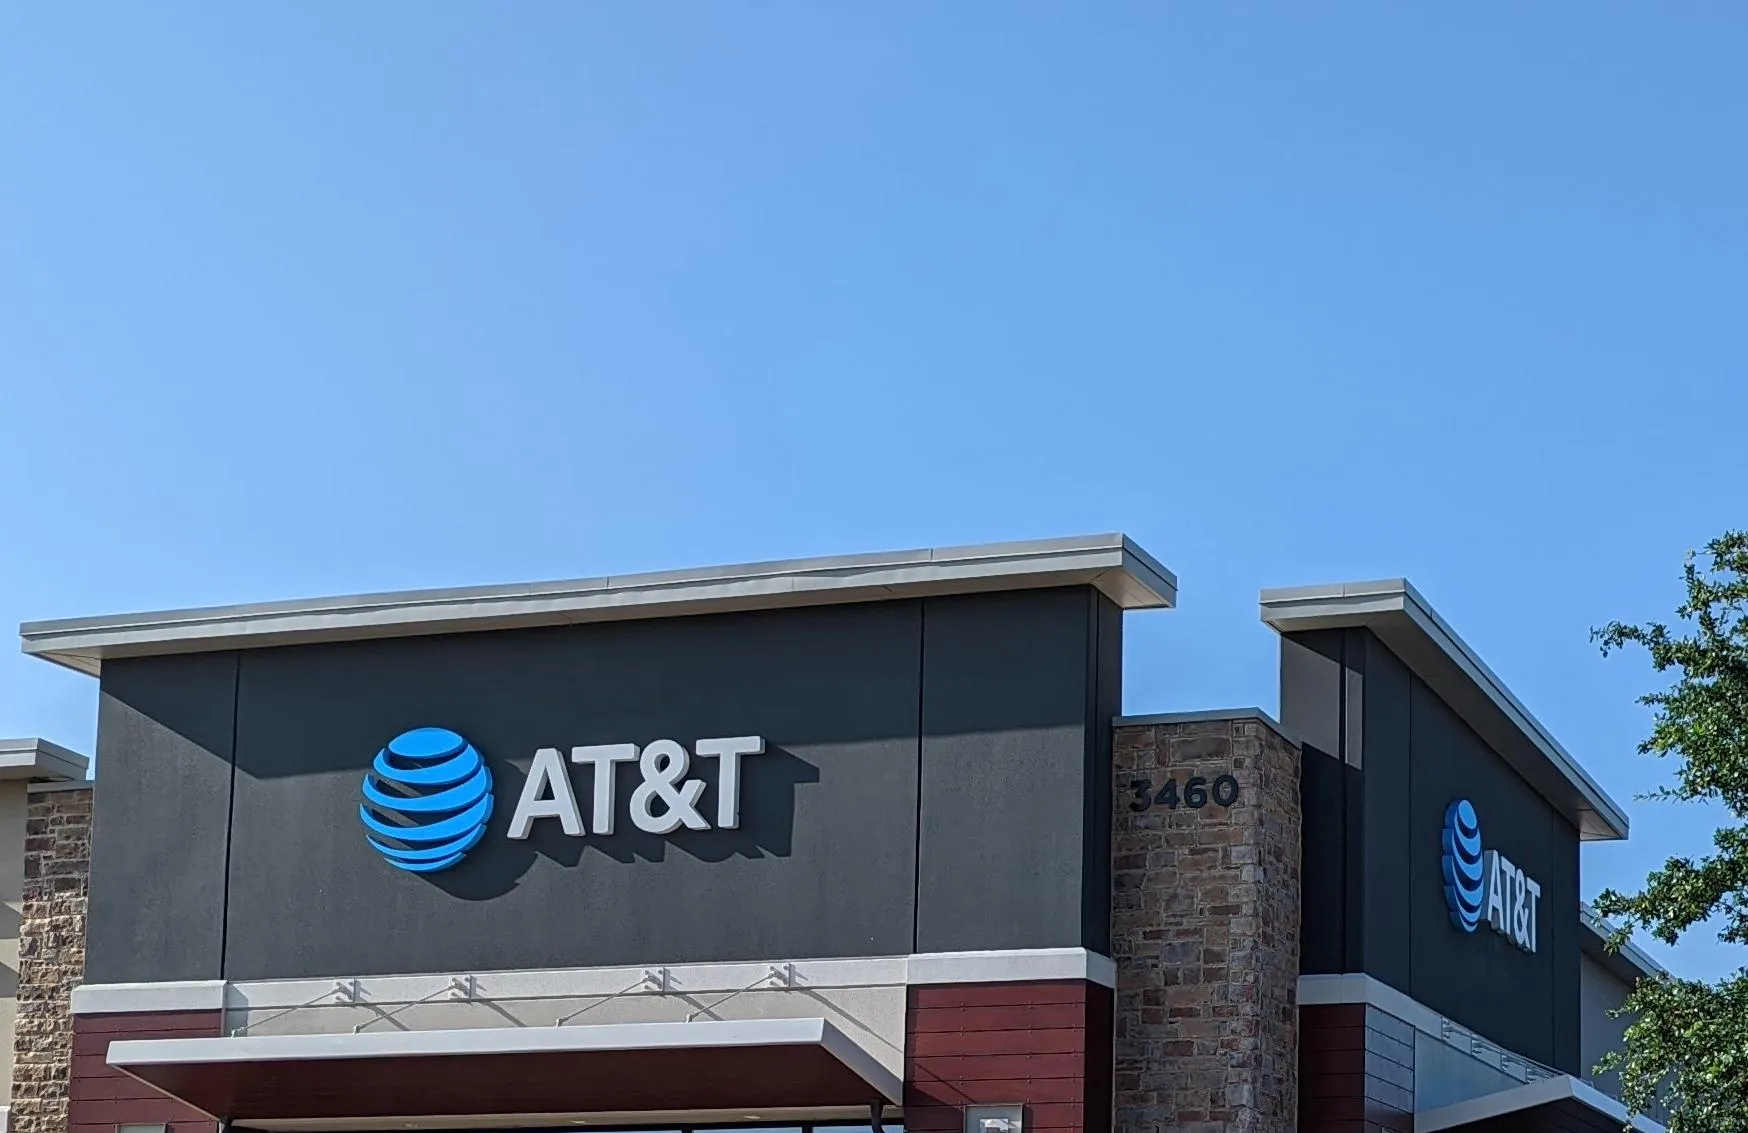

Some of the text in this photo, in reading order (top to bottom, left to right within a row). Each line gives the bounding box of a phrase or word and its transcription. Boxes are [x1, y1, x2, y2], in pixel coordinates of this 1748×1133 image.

[507, 735, 766, 839] AT&T
[1129, 774, 1239, 812] 3460
[1485, 850, 1541, 953] AT&T
